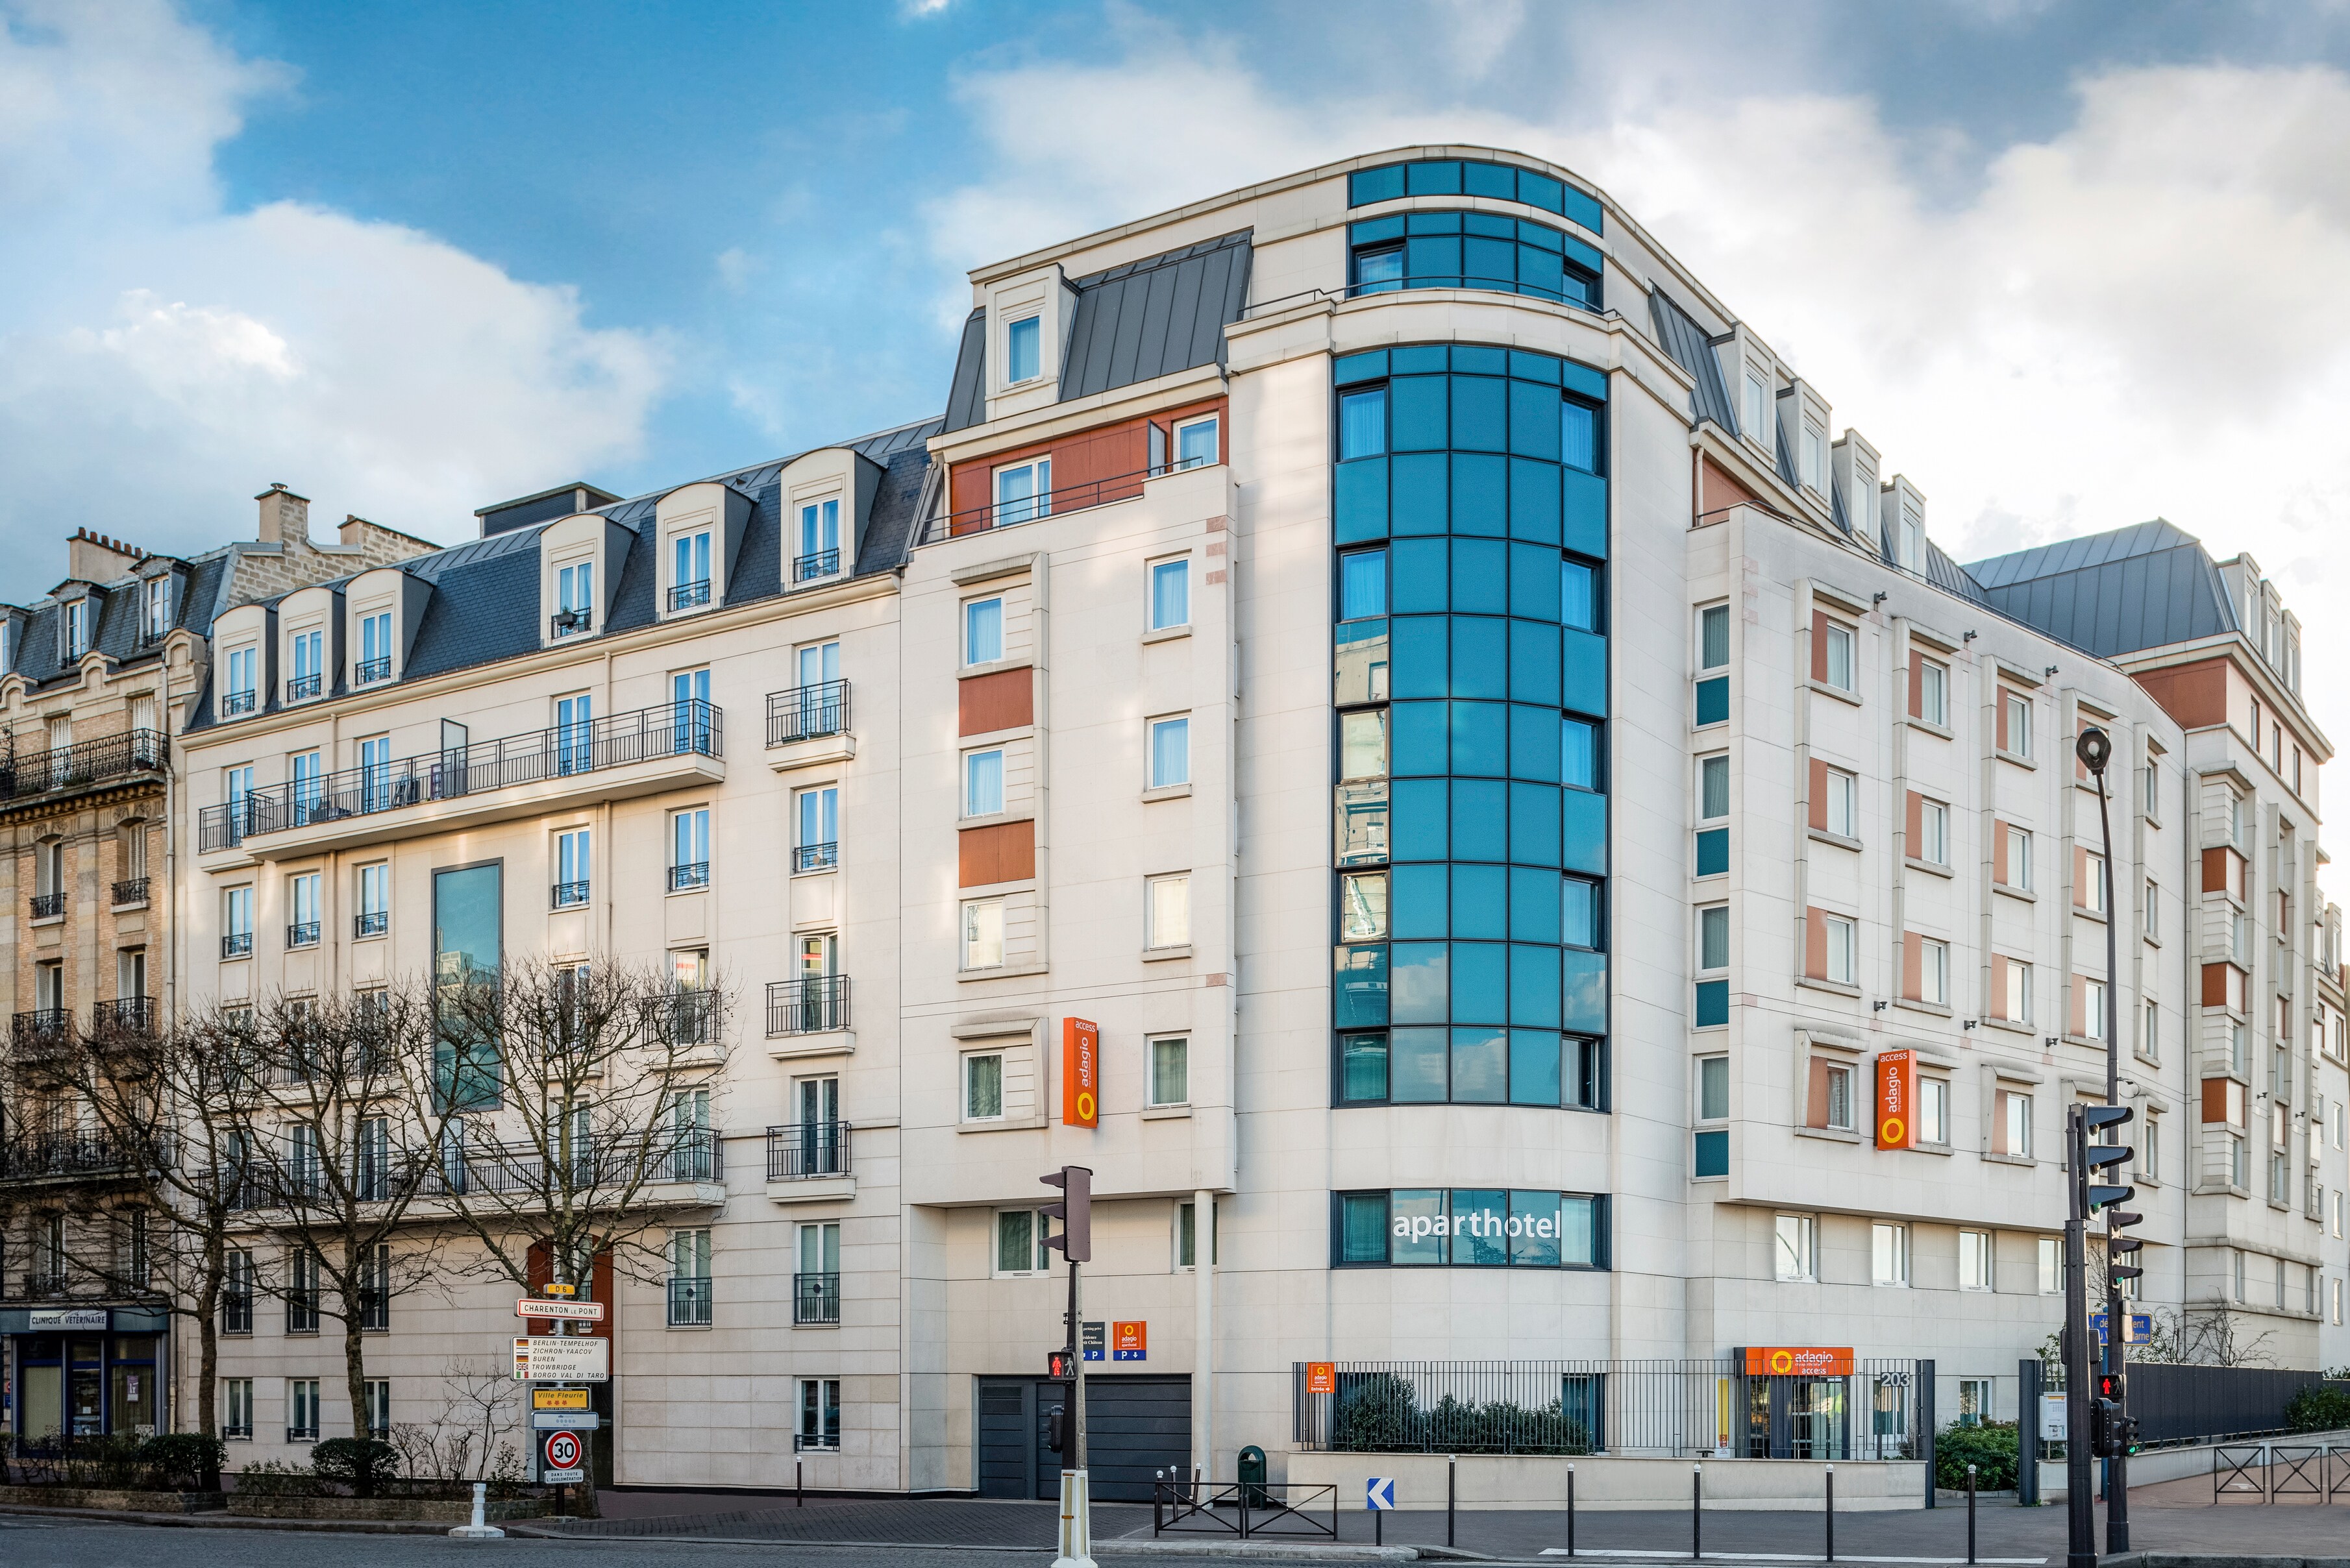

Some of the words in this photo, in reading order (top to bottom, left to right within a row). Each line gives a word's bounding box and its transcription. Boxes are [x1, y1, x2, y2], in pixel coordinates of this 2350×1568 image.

[1075, 1020, 1095, 1033] access
[1079, 1036, 1091, 1087] adagio
[1880, 1052, 1907, 1062] access
[1885, 1066, 1901, 1112] adagio
[1392, 1208, 1561, 1243] aparthotel
[525, 1305, 568, 1314] CHARENTON
[32, 1316, 61, 1325] CLINIQUE
[2132, 1331, 2149, 1341] arne
[1092, 1351, 1098, 1360] P
[1122, 1351, 1128, 1360] P
[1795, 1349, 1833, 1365] adagio
[1881, 1372, 1910, 1387] 203
[554, 1442, 575, 1458] 30
